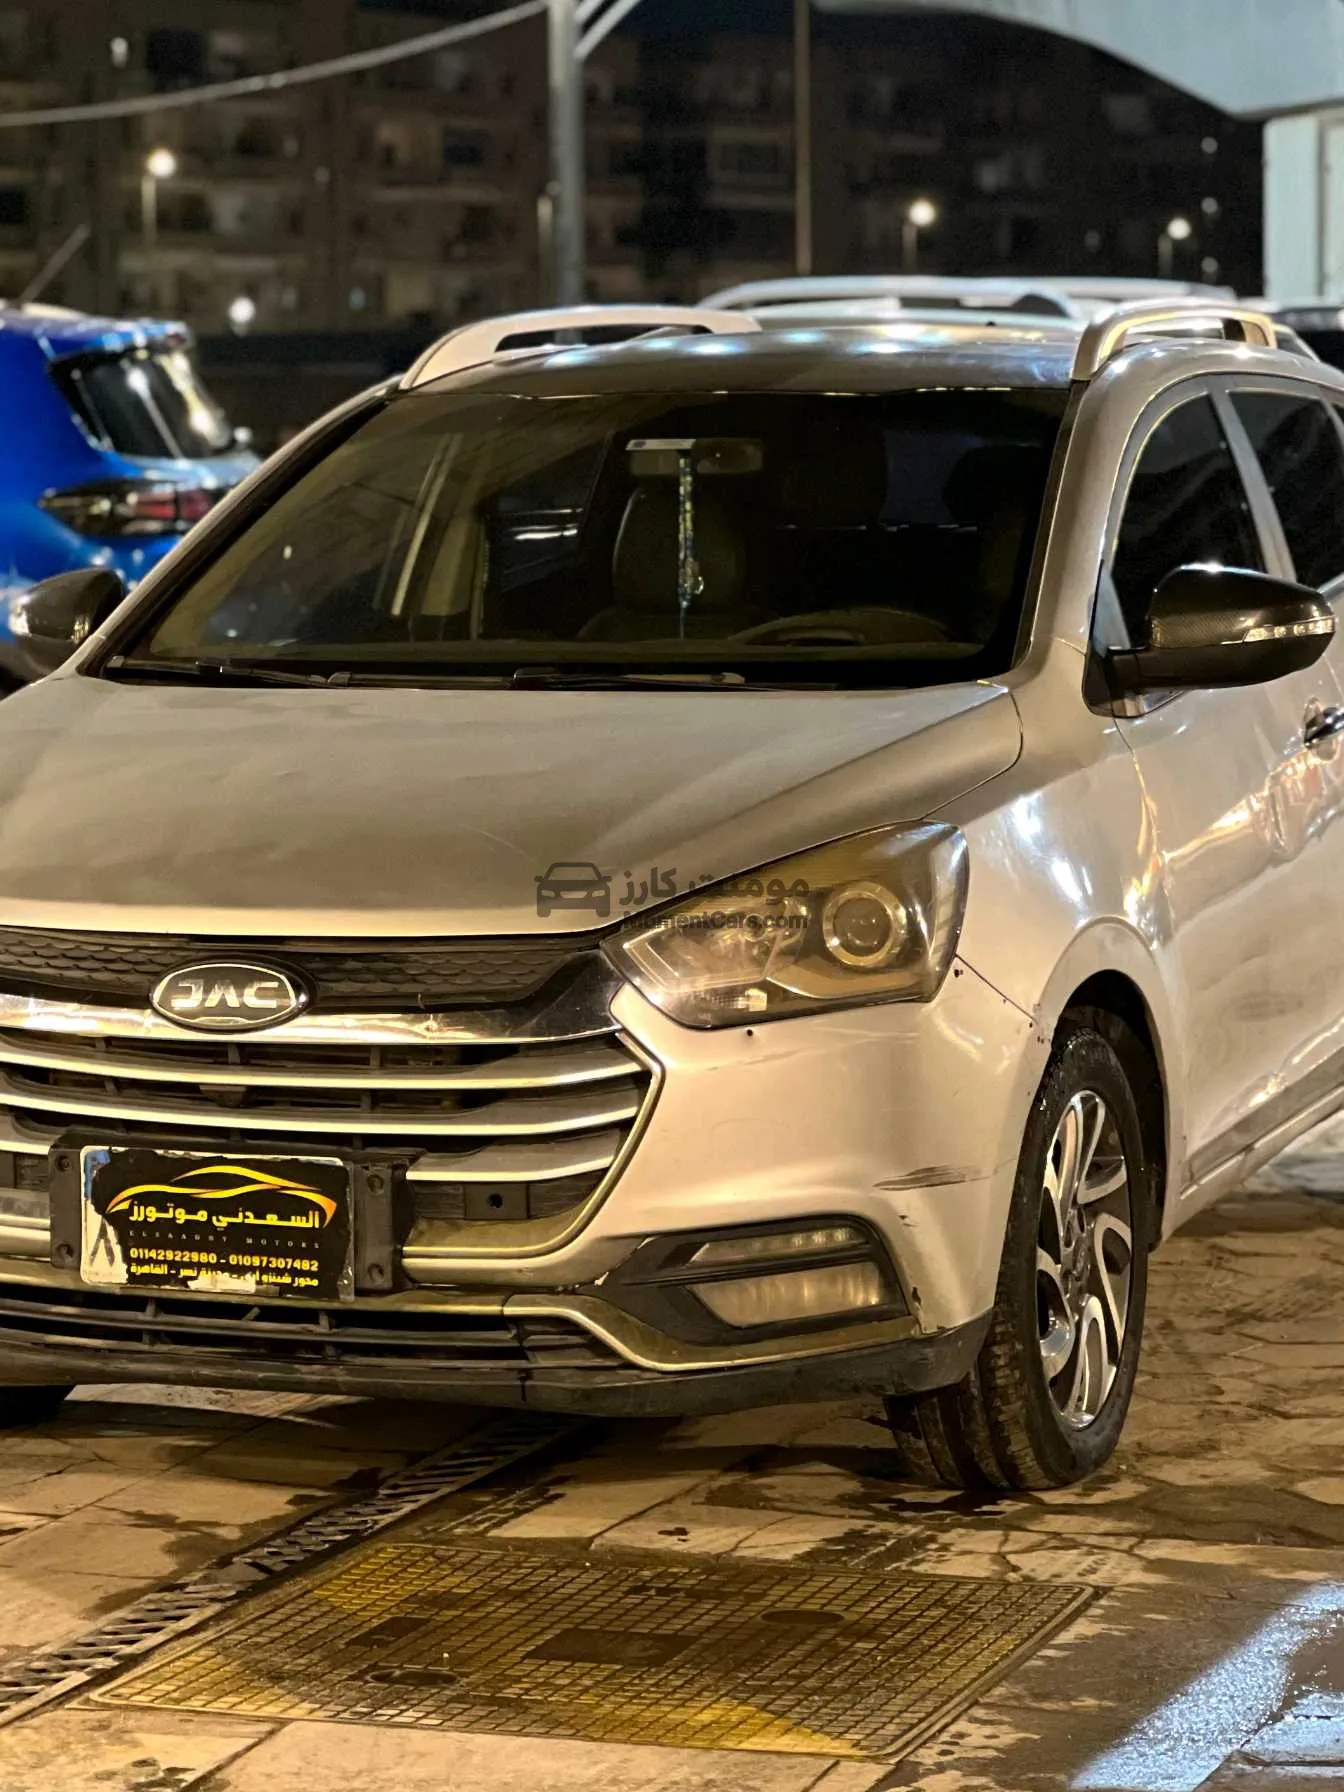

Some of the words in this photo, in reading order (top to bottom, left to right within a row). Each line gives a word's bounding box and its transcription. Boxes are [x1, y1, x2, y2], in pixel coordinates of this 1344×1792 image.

[169, 979, 280, 1010] JAC
[129, 1200, 208, 1225] موتورز
[212, 1208, 320, 1231] السعدني
